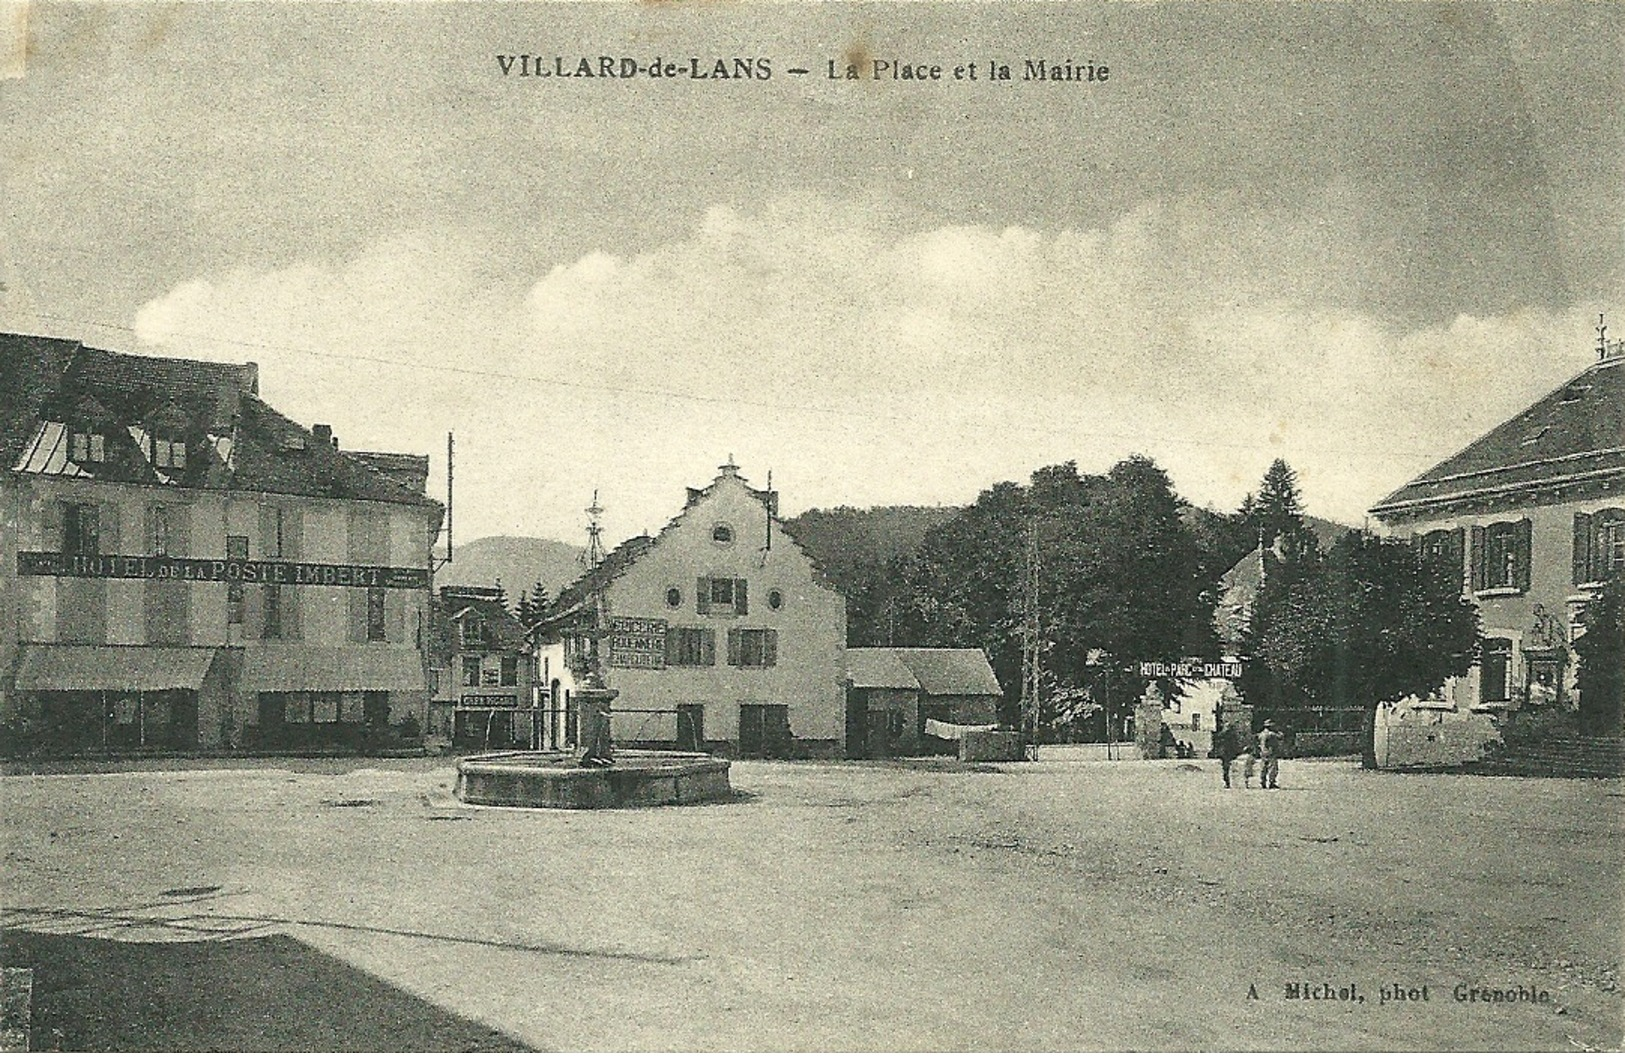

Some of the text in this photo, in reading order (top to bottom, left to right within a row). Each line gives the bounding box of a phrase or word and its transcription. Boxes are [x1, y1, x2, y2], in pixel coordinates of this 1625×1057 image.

[211, 561, 287, 582] POSTE
[295, 565, 381, 586] IMBERT
[1140, 661, 1167, 676] HOTEL
[1170, 663, 1193, 677] PARC
[1203, 663, 1243, 678] CHATEAU
